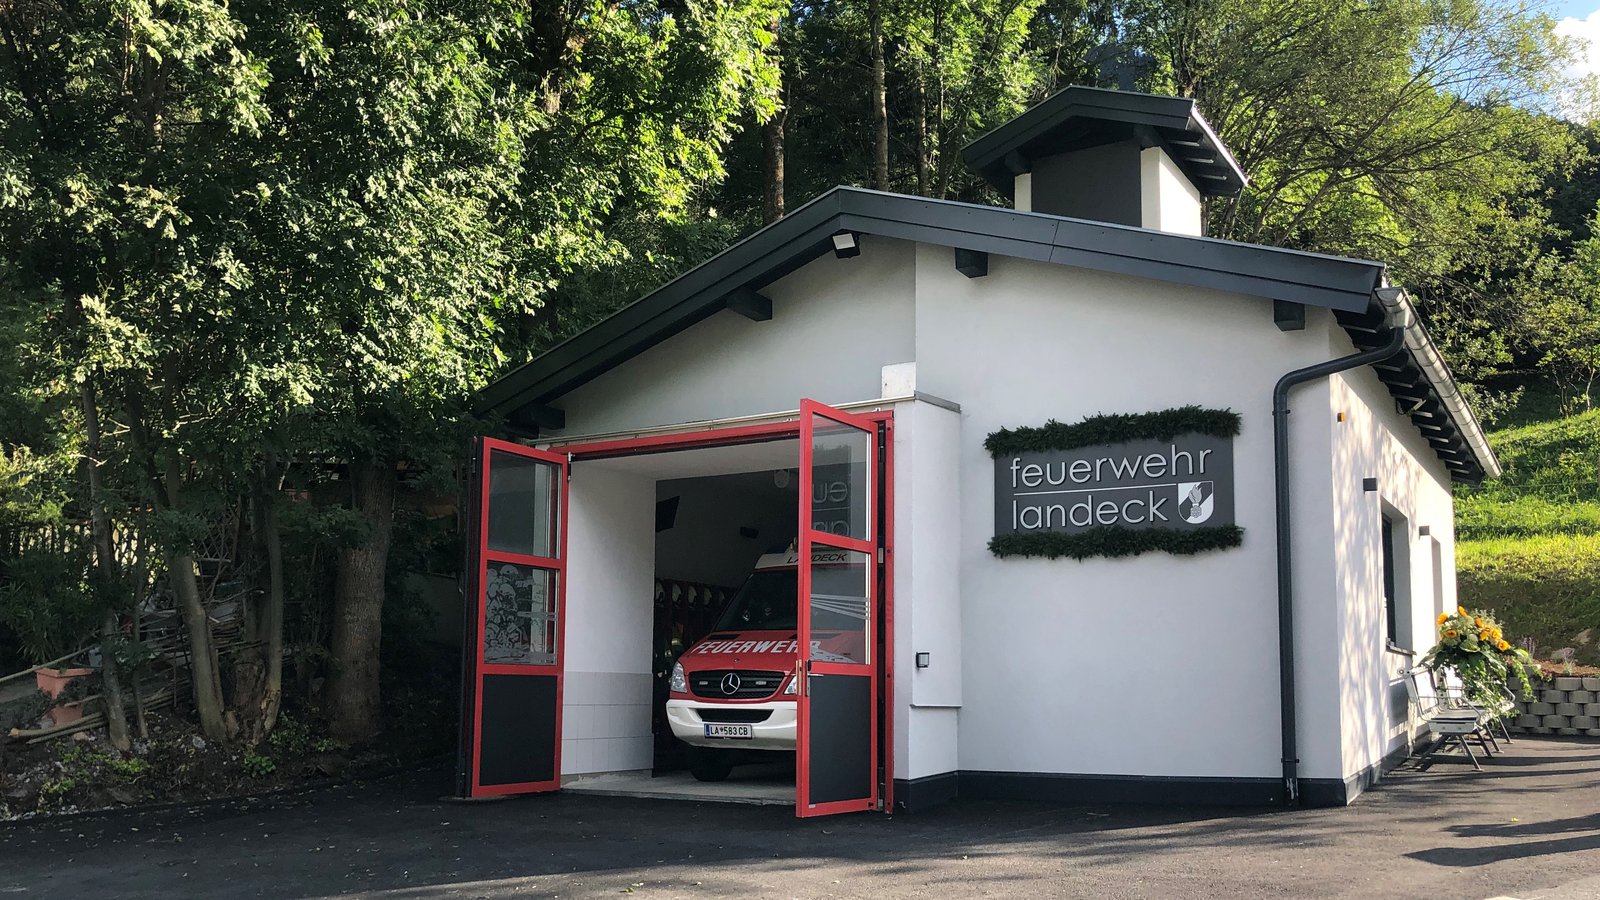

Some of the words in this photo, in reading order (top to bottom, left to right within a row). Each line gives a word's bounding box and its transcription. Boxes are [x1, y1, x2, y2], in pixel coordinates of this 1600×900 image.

[1010, 444, 1212, 488] feuerwehr
[1012, 490, 1169, 530] landeck
[786, 553, 848, 564] LDECK
